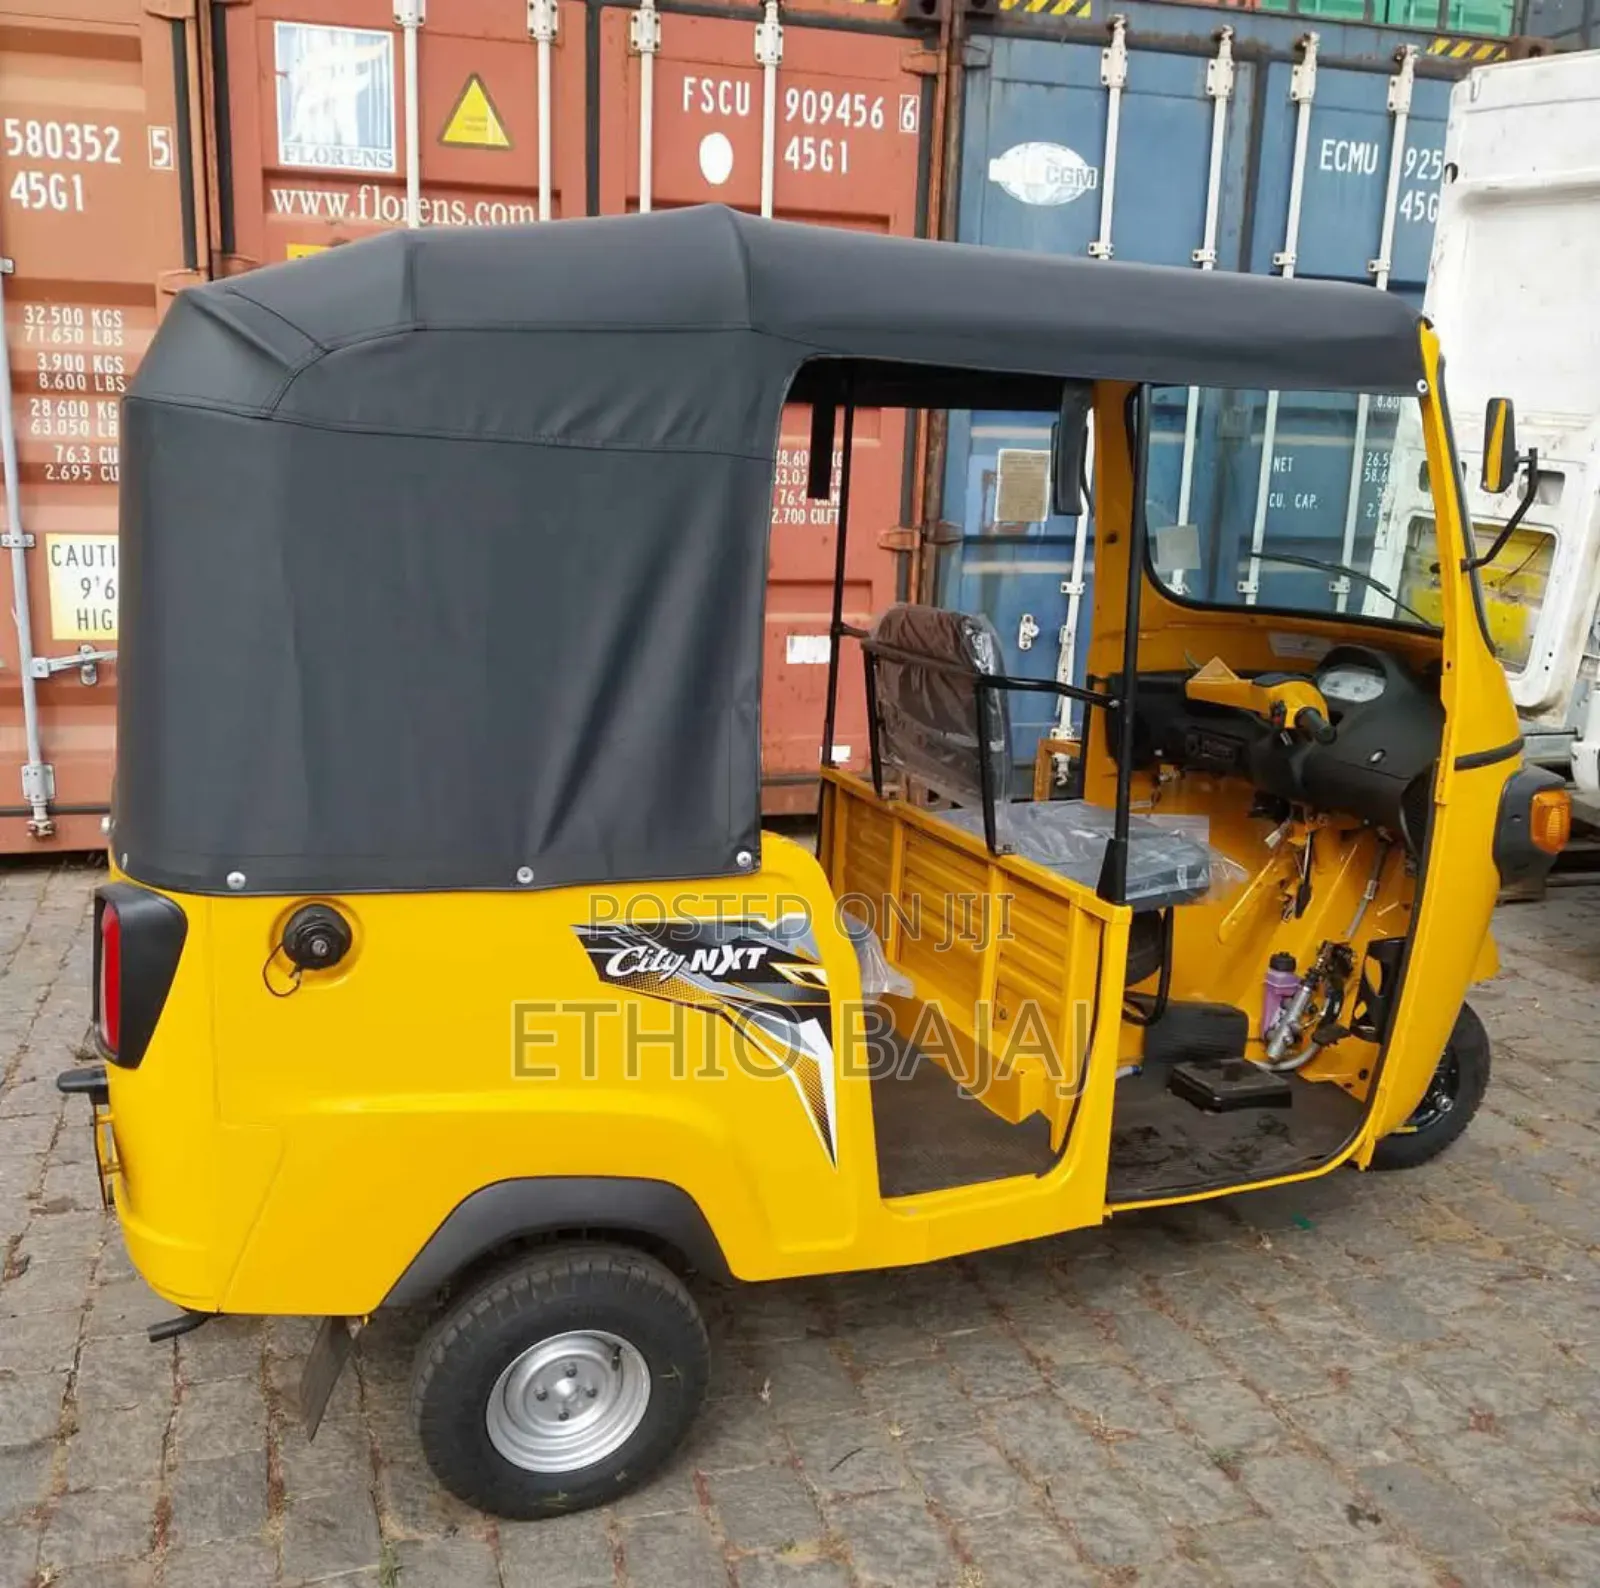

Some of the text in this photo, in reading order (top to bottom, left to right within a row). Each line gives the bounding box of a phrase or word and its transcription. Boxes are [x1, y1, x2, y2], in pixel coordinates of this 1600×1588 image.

[683, 76, 917, 131] FSCU 909456 6
[4, 118, 172, 168] 580352 5
[784, 136, 849, 174] 45G1
[283, 145, 393, 169] FLORENS
[1319, 138, 1443, 180] ECMU 925
[1045, 165, 1096, 187] CGM
[10, 171, 84, 212] 45G1
[270, 184, 535, 226] www.florens.com
[24, 304, 123, 328] 32.500 KGS
[92, 329, 123, 346] LBS
[37, 352, 125, 374] 3.900 KGS
[39, 372, 126, 392] 8.600 LBS
[55, 444, 91, 463] 76.3
[1273, 456, 1293, 473] NET
[45, 464, 92, 481] 2.695
[51, 544, 116, 568] CAUTI
[76, 607, 114, 631] HIG
[605, 944, 767, 985] City NXT
